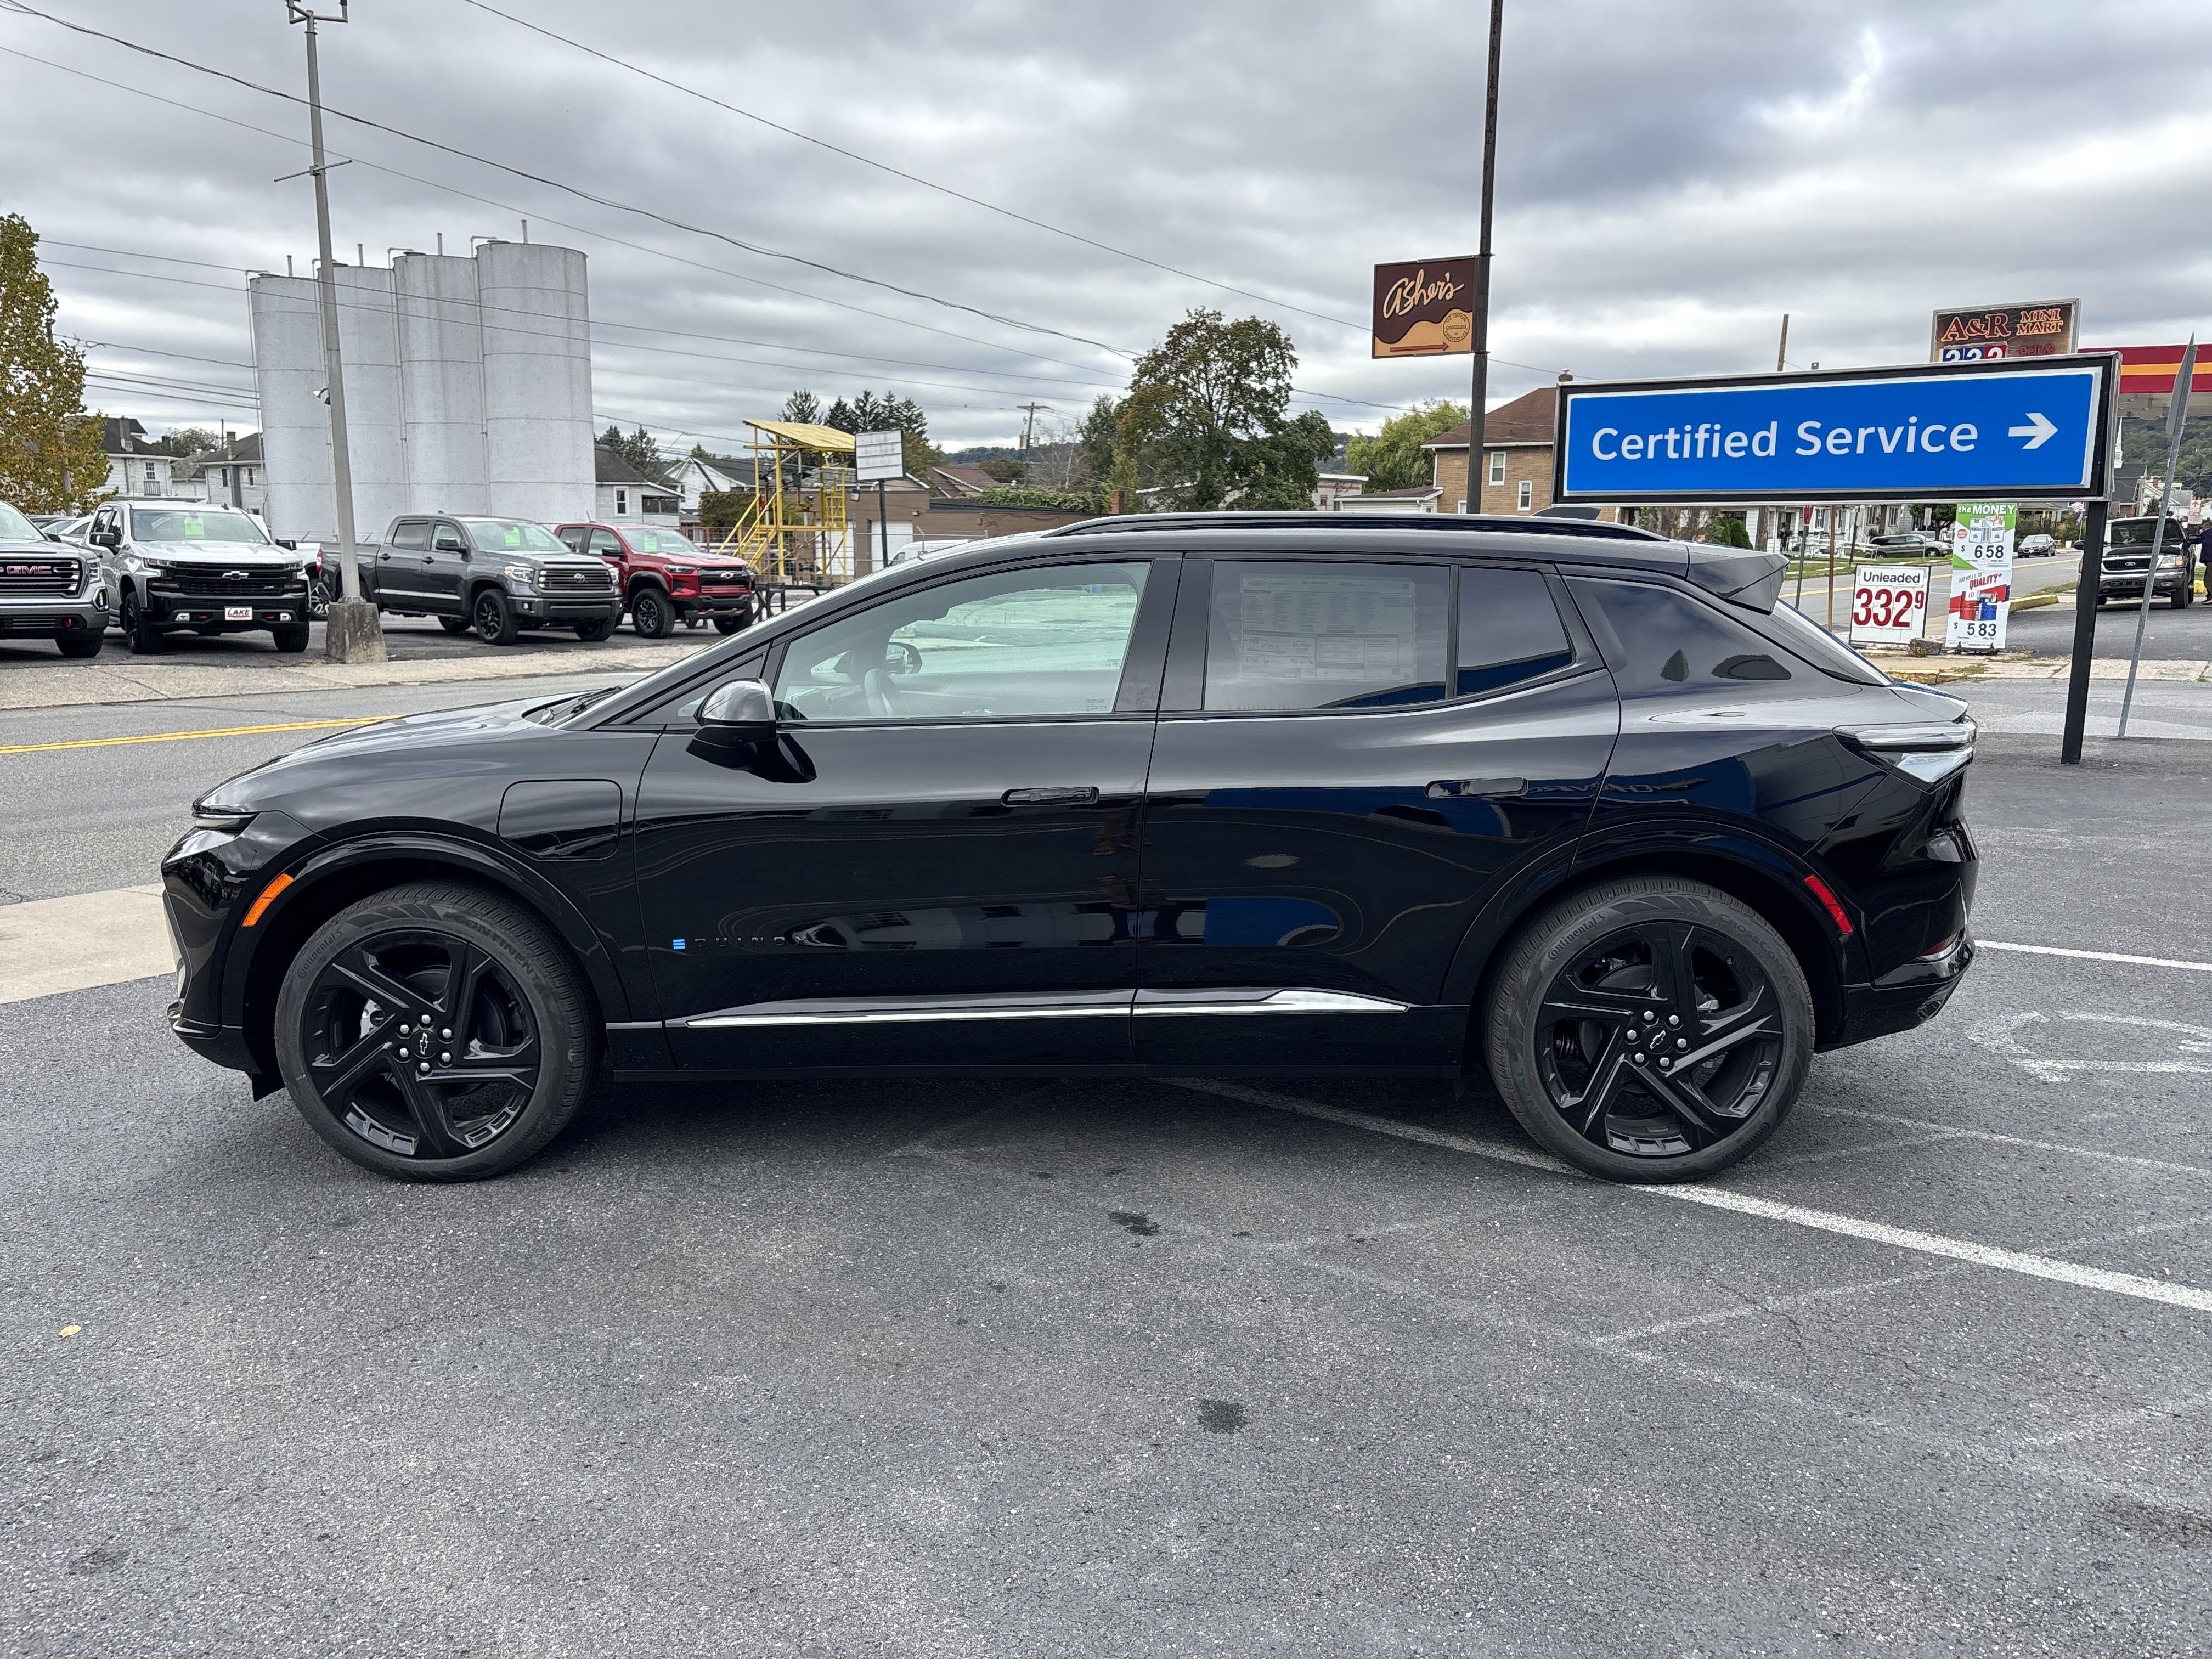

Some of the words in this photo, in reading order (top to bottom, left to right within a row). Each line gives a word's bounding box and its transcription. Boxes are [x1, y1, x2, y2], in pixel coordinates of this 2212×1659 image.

[2020, 308, 2061, 323] MINI
[1941, 313, 2011, 342] A&R
[2016, 321, 2063, 336] MART
[1592, 421, 1778, 460] Certified
[1795, 416, 1978, 456] Service
[1972, 504, 2016, 515] MONEY
[7, 566, 52, 574] GMC
[1863, 571, 1920, 583] Unleaded
[228, 608, 250, 617] LAKE
[1547, 917, 1598, 960] Continental
[298, 933, 337, 979] Continental
[454, 915, 549, 995] CONTINENTA
